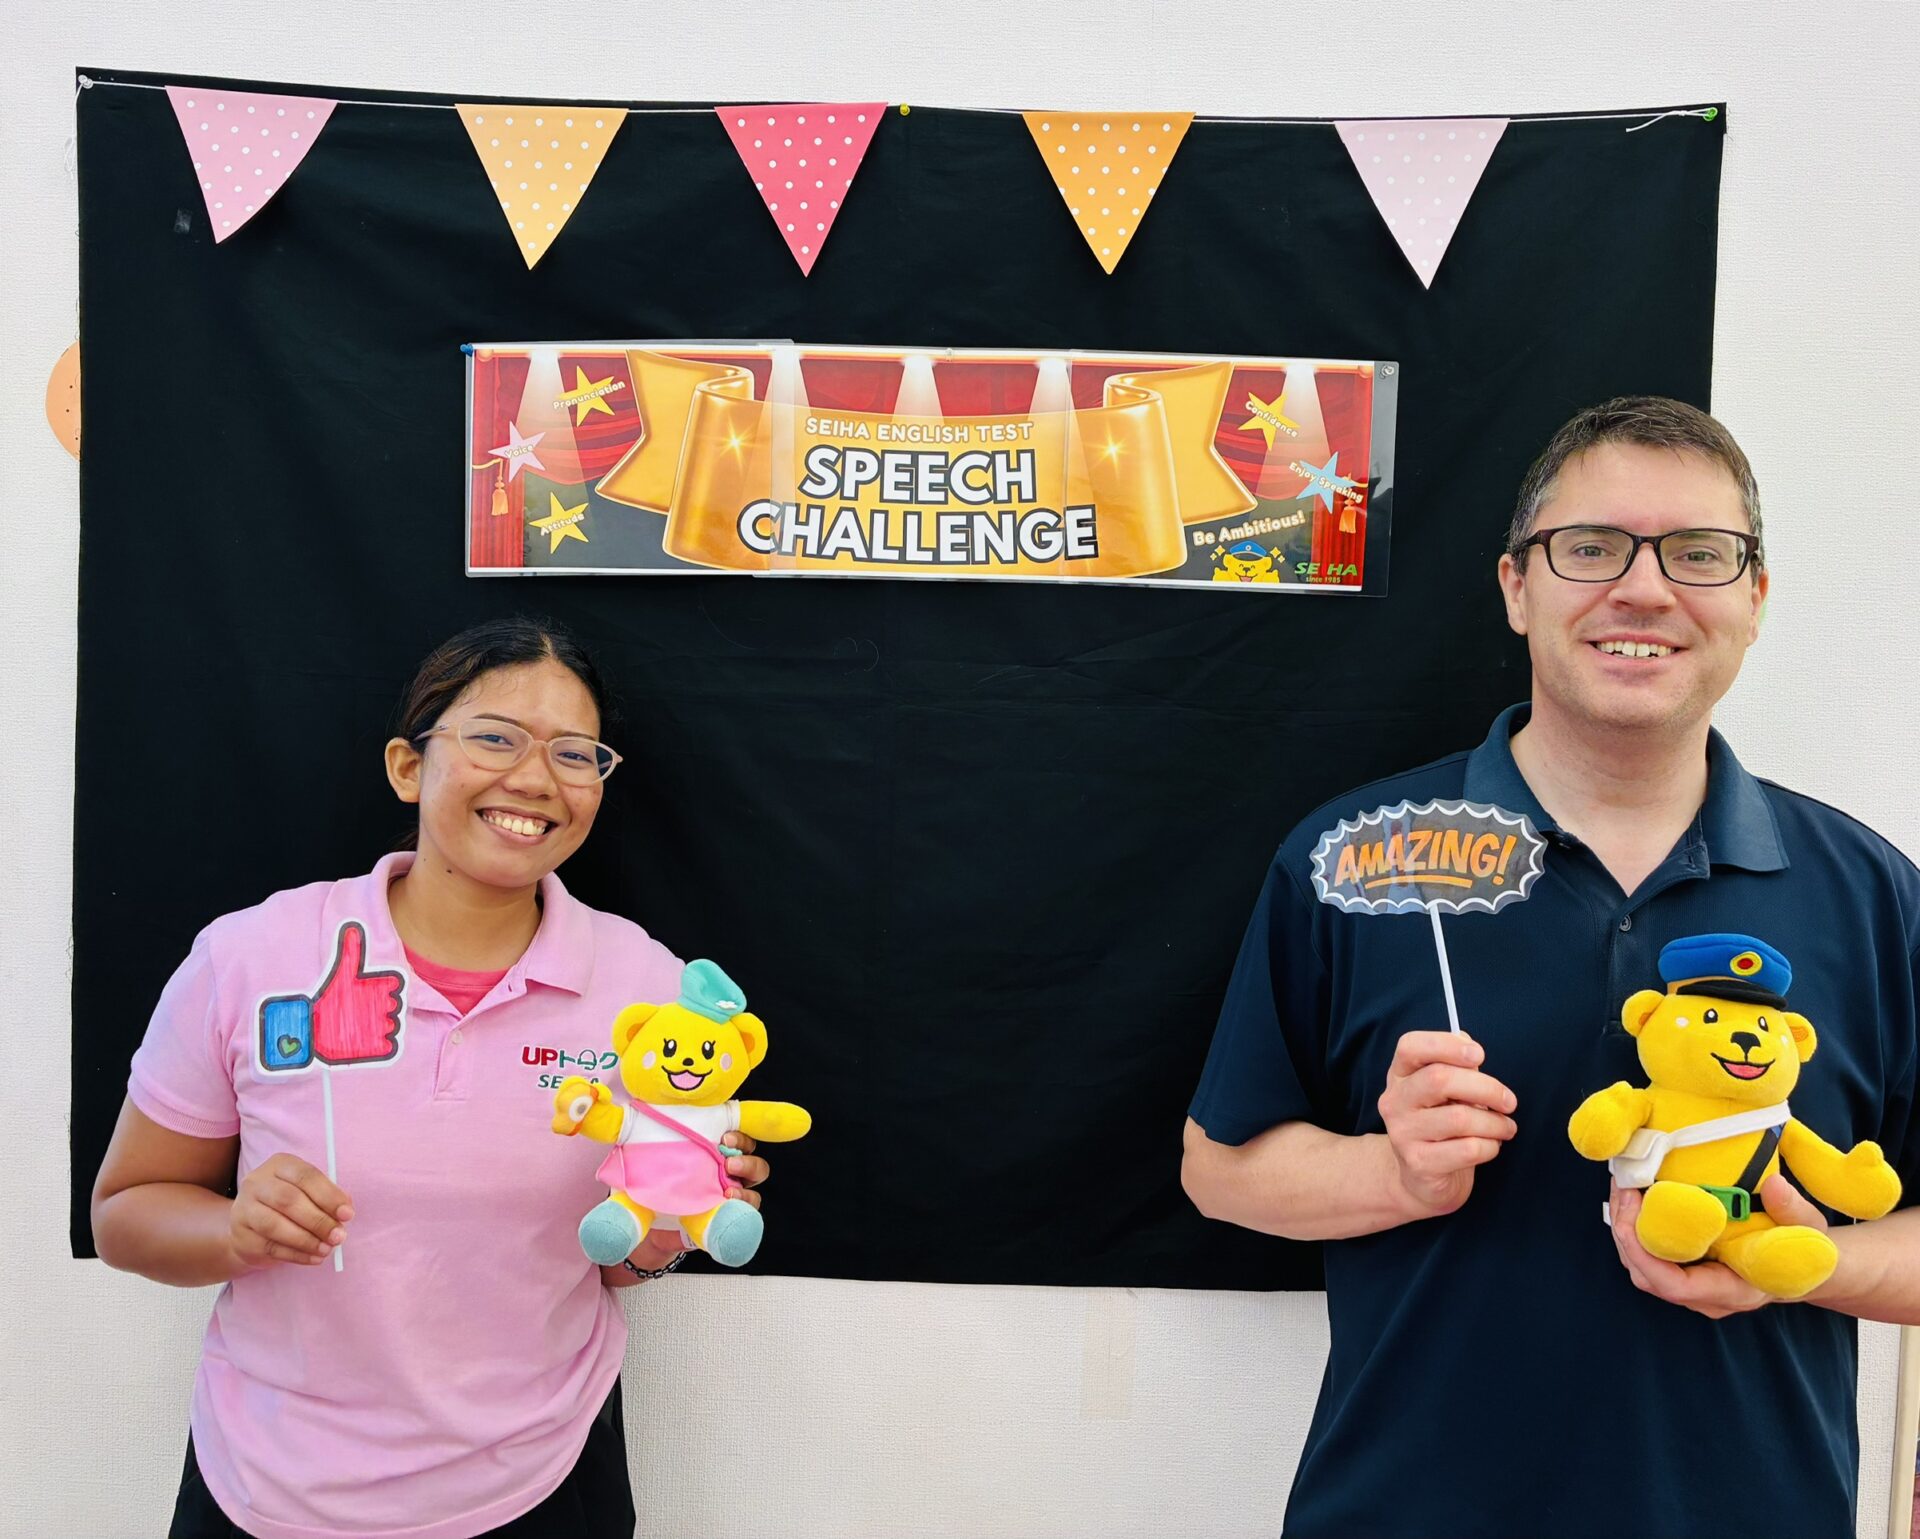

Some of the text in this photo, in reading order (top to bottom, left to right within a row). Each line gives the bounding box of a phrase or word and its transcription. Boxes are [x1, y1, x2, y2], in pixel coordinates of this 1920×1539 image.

[552, 380, 626, 410] Pronunciation
[805, 417, 1034, 443] SEIHA ENGLISH TEST
[1245, 401, 1299, 438] Confidence
[504, 442, 535, 459] Voice
[798, 445, 1037, 505] SPEECH
[1289, 462, 1364, 504] Enjoy Speaking
[540, 512, 585, 537] Attitude
[736, 499, 1099, 565] CHALLENGE
[1193, 510, 1306, 547] Be Ambitious!
[1334, 829, 1517, 887] AMAZING!
